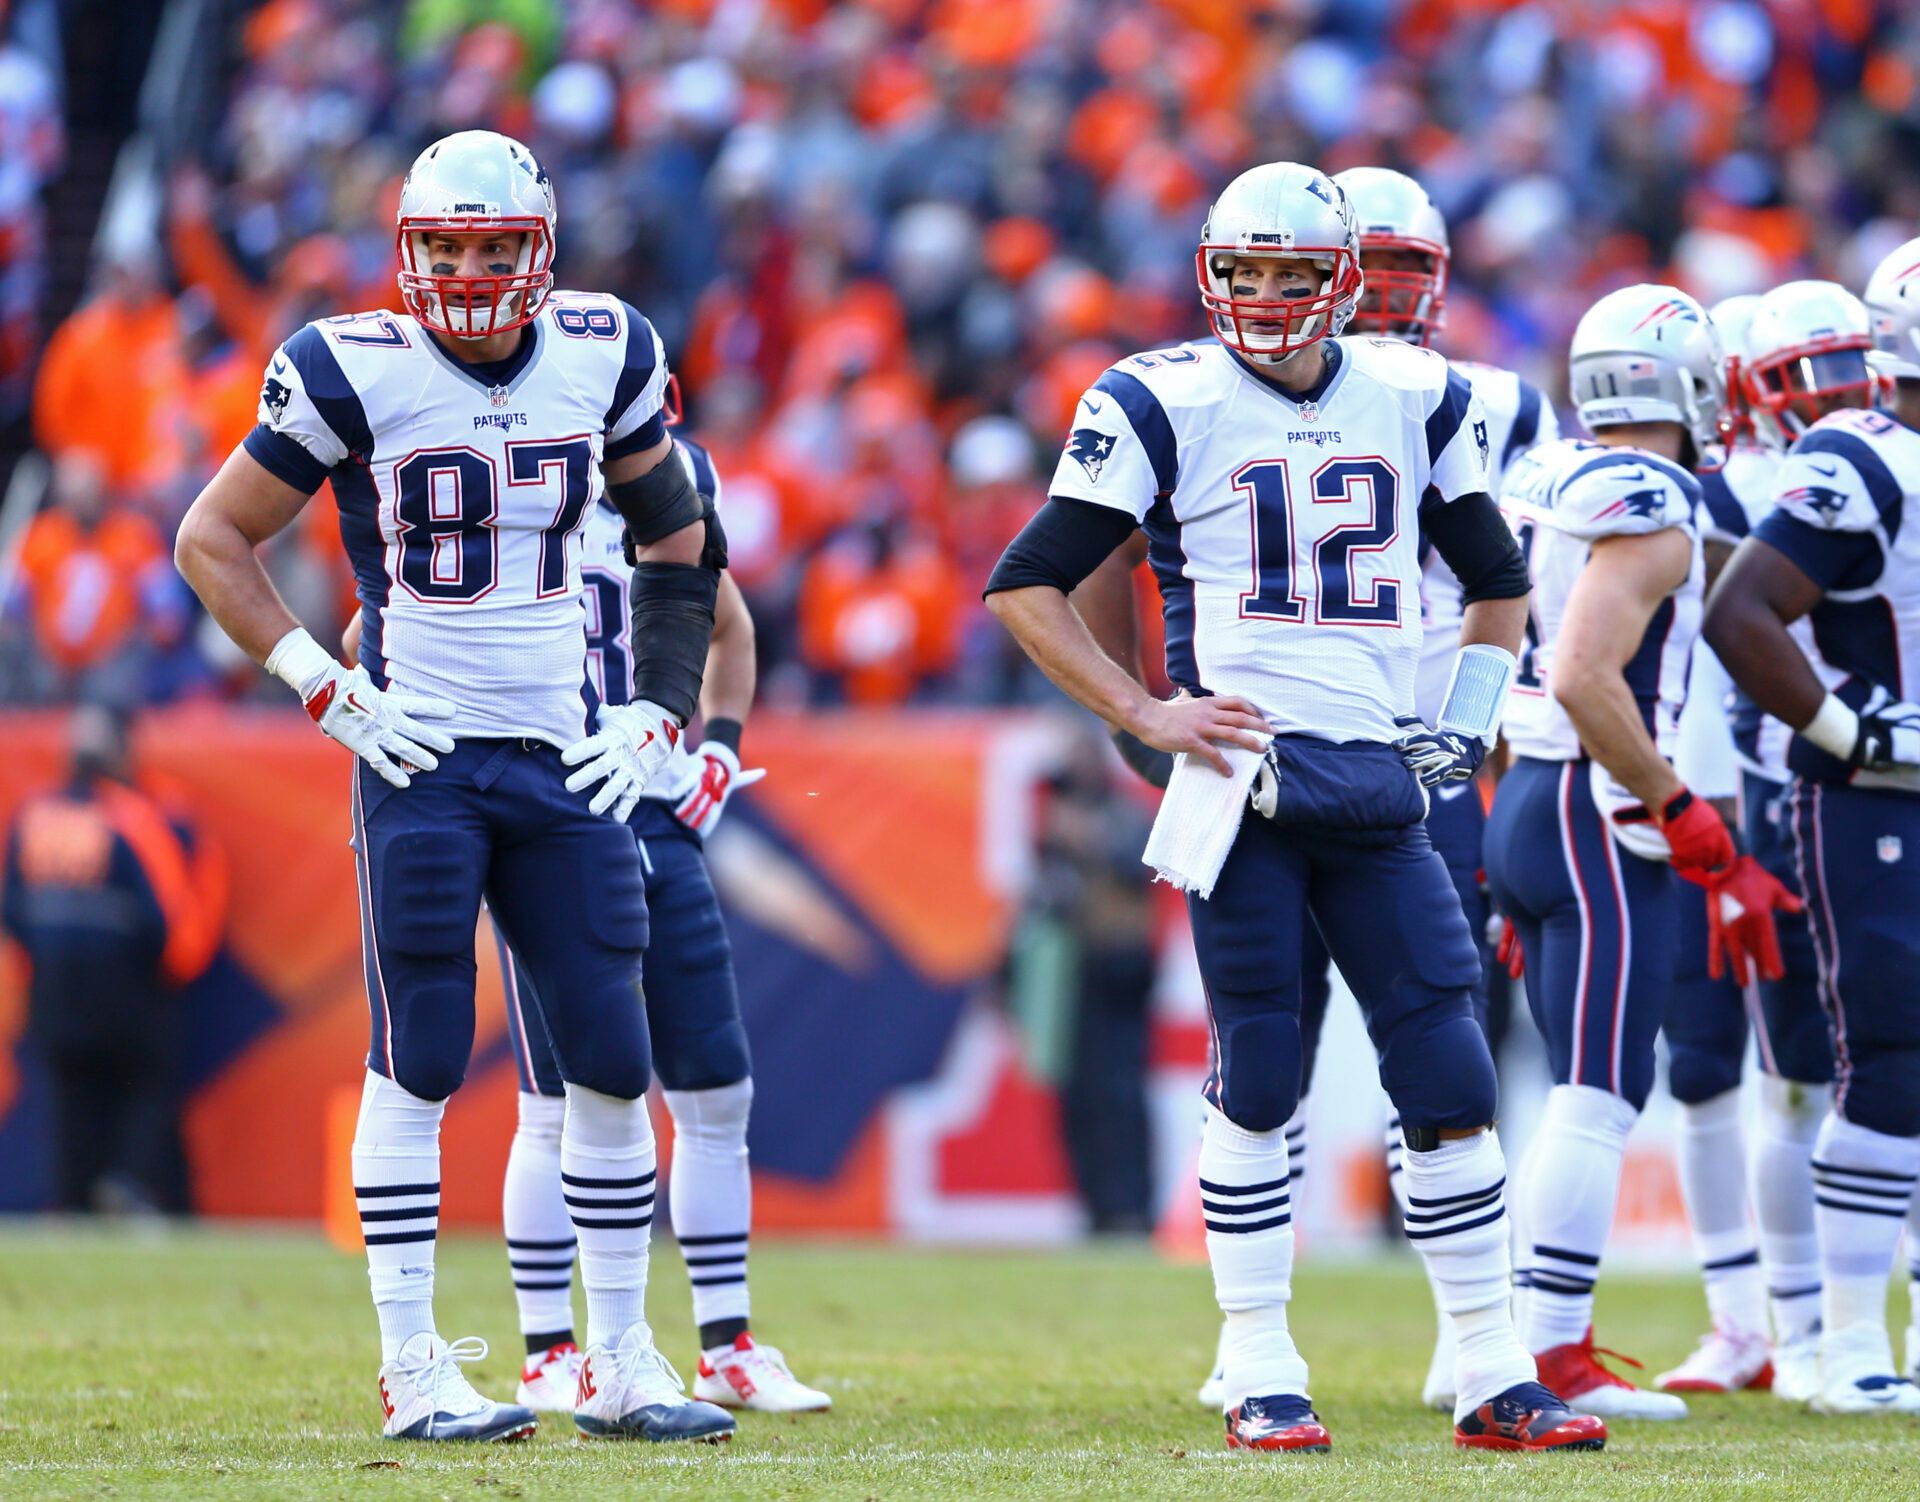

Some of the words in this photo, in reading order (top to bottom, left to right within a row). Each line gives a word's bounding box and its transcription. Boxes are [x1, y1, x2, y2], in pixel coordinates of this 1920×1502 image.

[454, 203, 486, 214] PATRIOTS
[1589, 372, 1619, 399] 11
[473, 412, 528, 430] PATRIOTS
[1287, 431, 1342, 444] PATRIOTS
[393, 433, 595, 605] 87
[1231, 455, 1402, 629] 12
